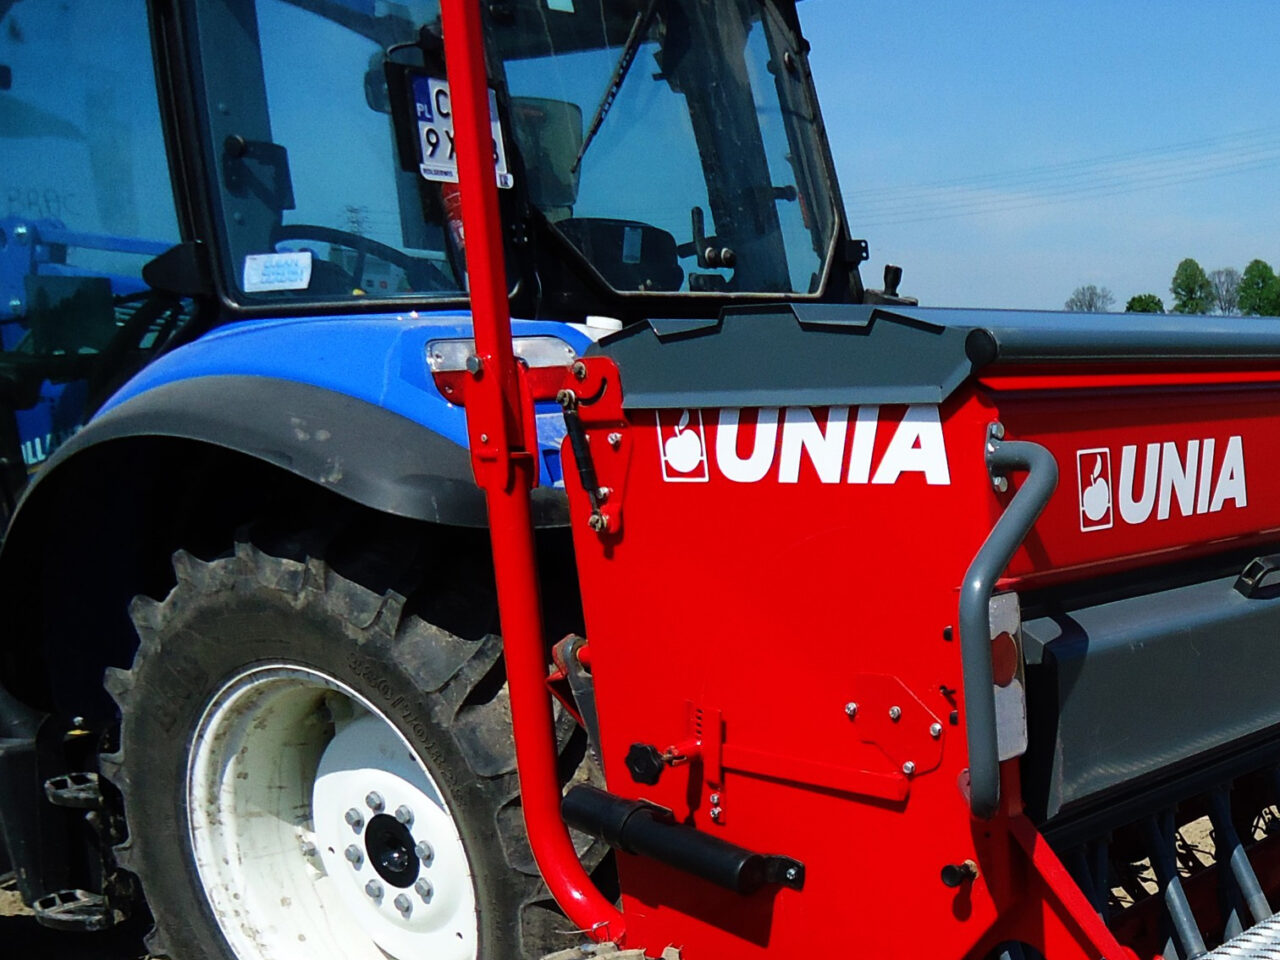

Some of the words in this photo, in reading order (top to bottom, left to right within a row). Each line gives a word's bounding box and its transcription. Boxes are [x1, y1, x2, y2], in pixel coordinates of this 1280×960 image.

[415, 102, 432, 119] PL
[716, 404, 951, 485] UNIA
[1118, 435, 1248, 525] UNIA
